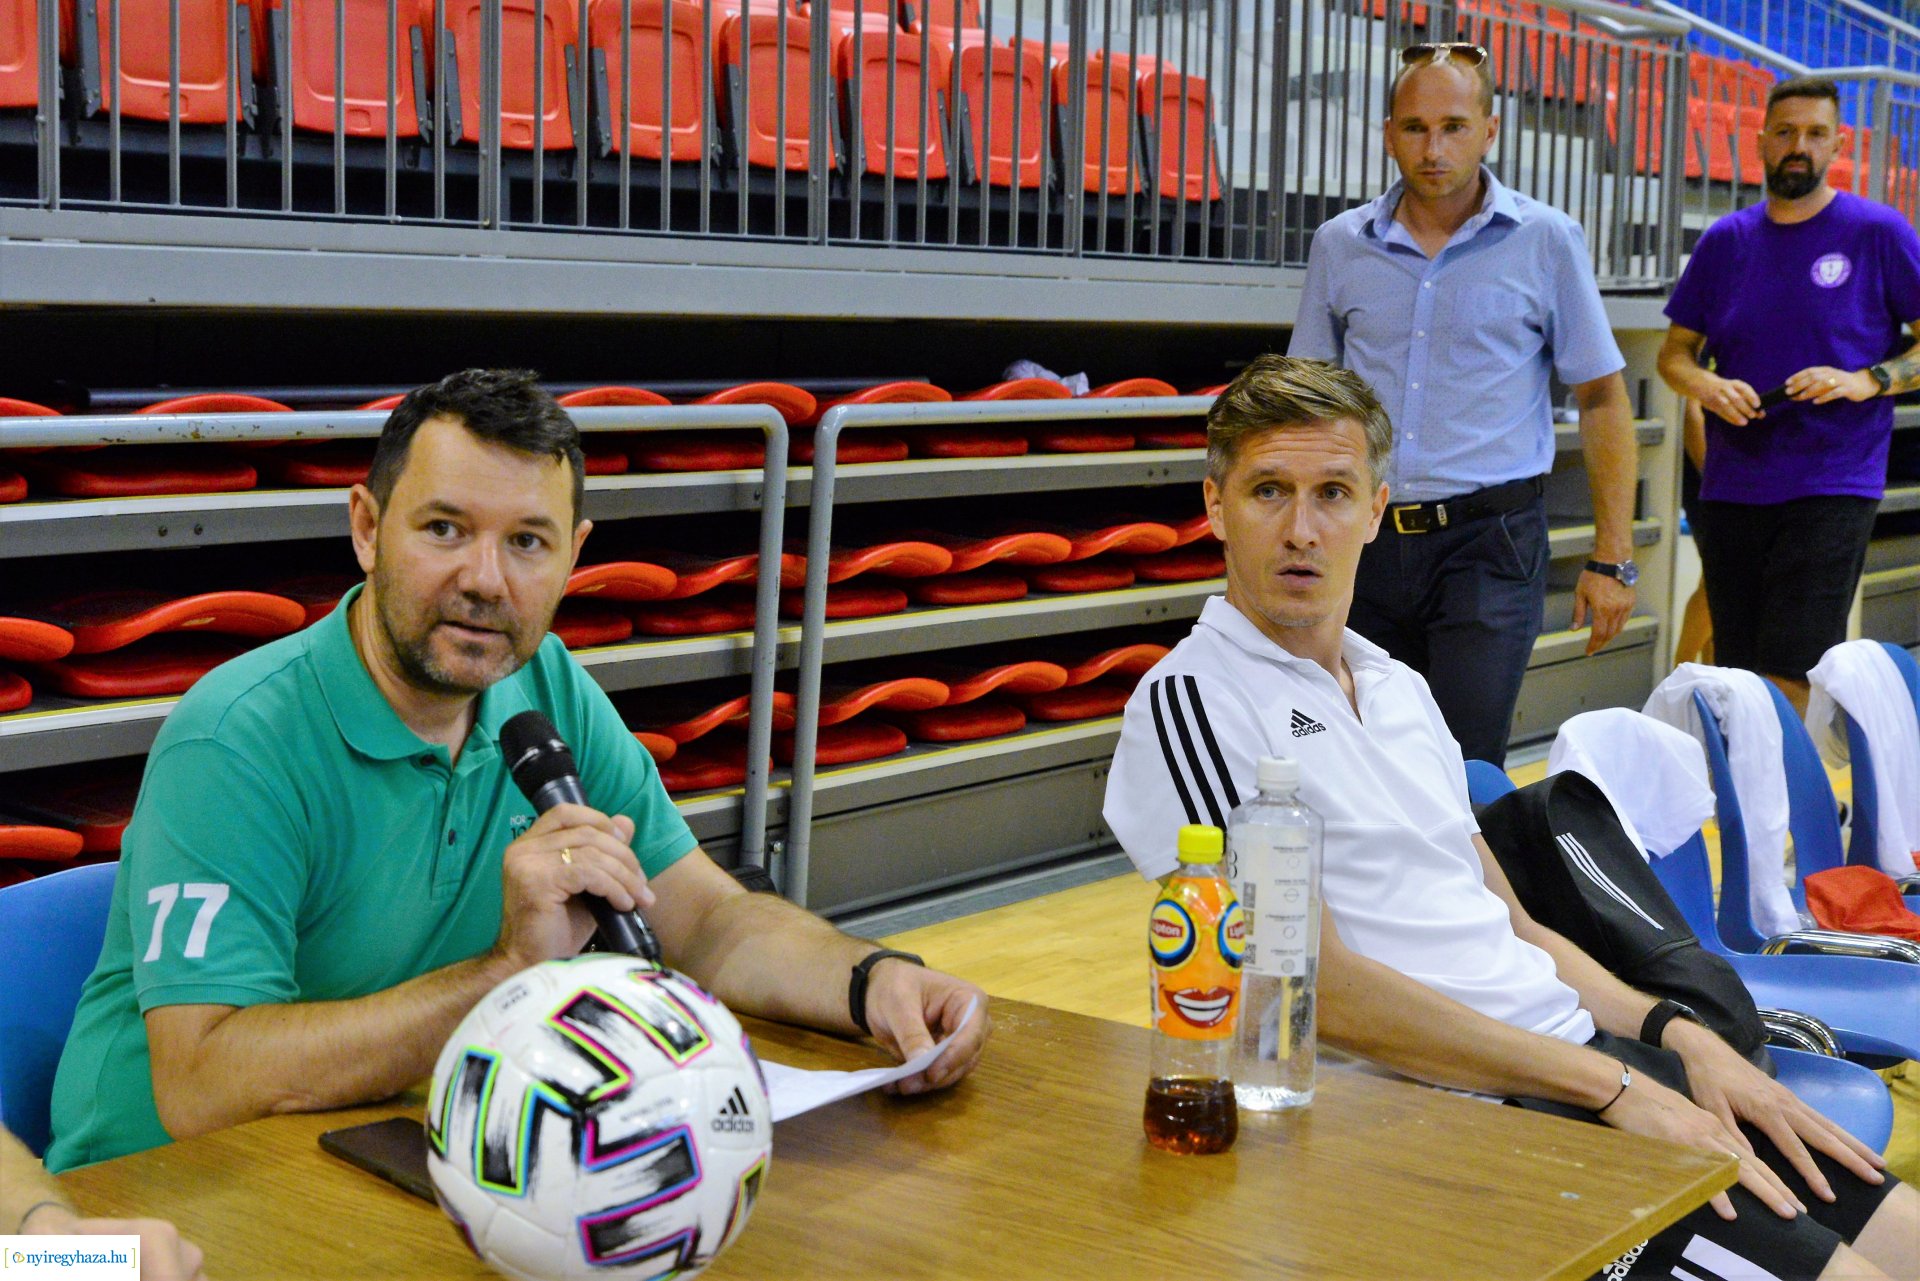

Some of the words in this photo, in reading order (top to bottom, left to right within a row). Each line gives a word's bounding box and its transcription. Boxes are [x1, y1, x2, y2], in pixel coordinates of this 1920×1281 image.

[1291, 722, 1326, 738] adidas
[142, 882, 230, 963] 77
[711, 1115, 755, 1133] adidas
